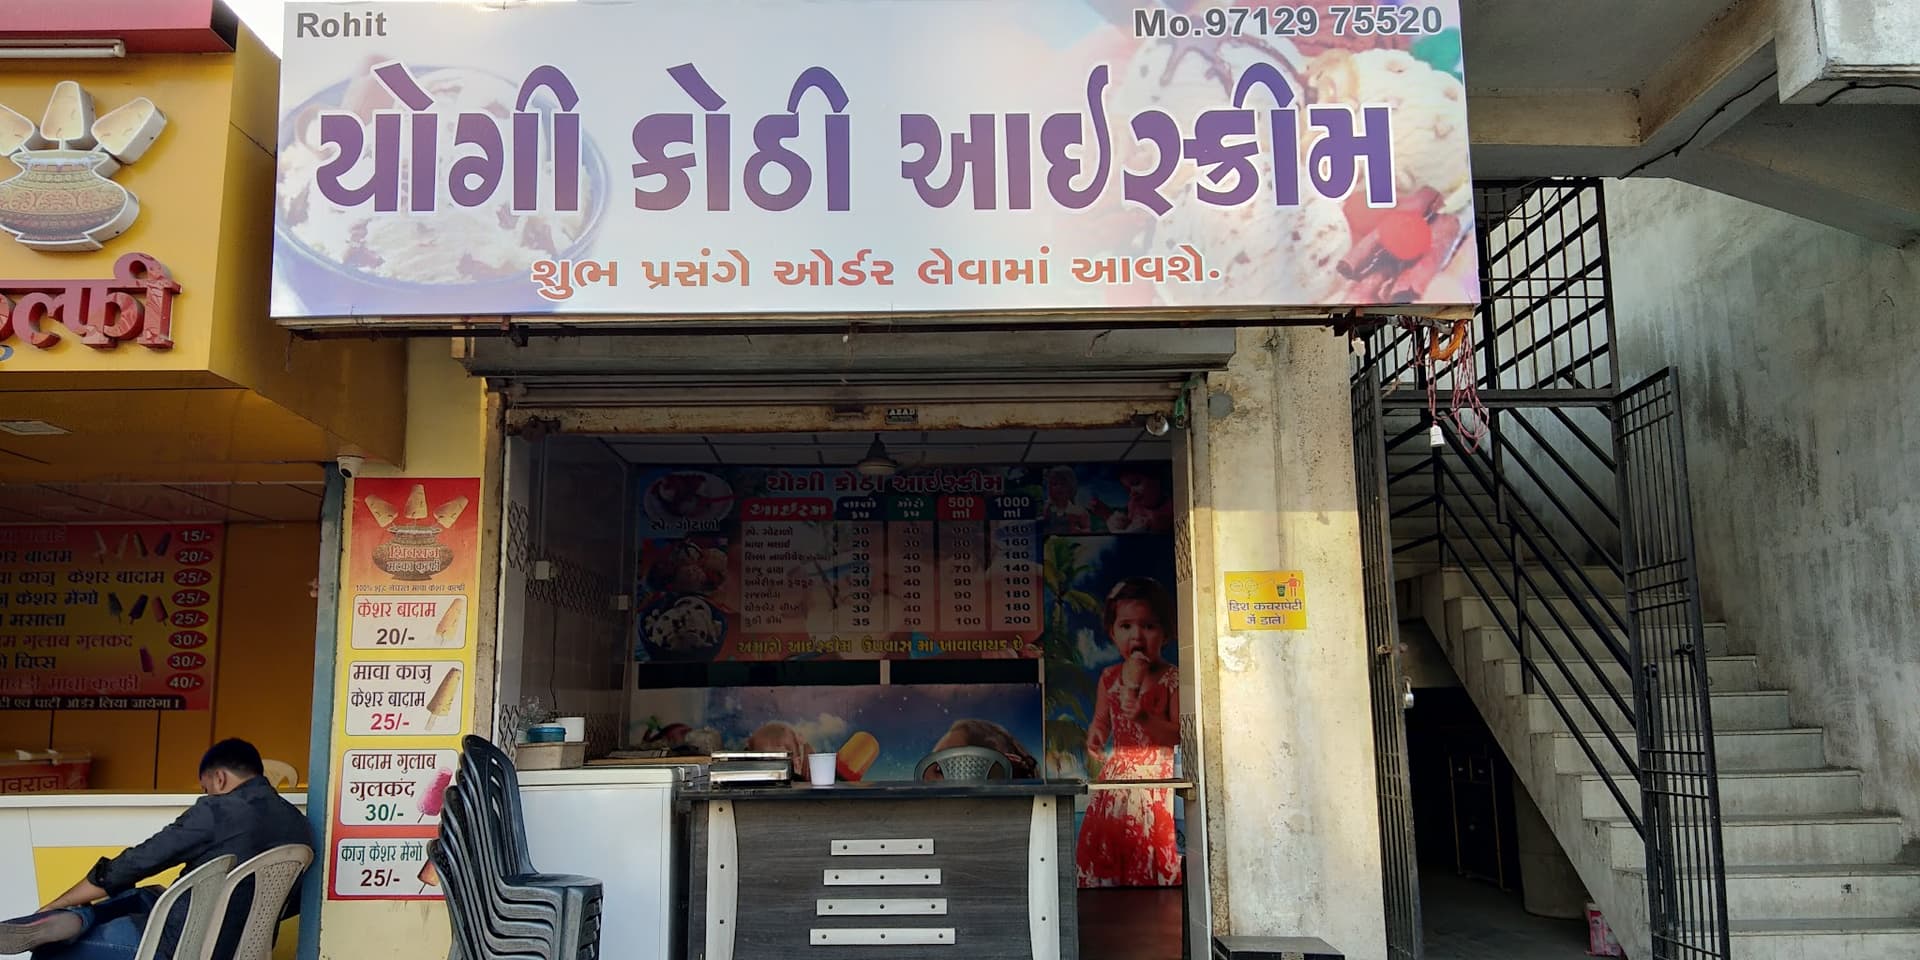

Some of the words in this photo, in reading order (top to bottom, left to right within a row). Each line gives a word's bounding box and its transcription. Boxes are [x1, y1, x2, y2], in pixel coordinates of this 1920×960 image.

[296, 11, 387, 38] Rohit
[1133, 7, 1319, 40] Mo.97129
[1331, 4, 1444, 37] 75520
[315, 61, 581, 213] યોગી
[630, 61, 851, 213] કોઠી
[531, 259, 618, 301] શુભ
[641, 247, 750, 290] પ્રસંગે
[773, 247, 894, 286] ઓર્ડર
[917, 244, 1050, 286] લેવામાં
[0, 252, 183, 352] ल्फी
[766, 471, 825, 492] યોગી
[947, 496, 975, 508] 500
[995, 495, 1030, 508] 1000
[951, 507, 971, 519] ml
[1003, 507, 1021, 519] ml
[181, 530, 211, 541] 15/-
[852, 526, 870, 535] 30
[852, 539, 870, 548] 20
[179, 550, 210, 562] 20/-
[852, 552, 870, 561] 30
[904, 552, 921, 561] 40
[954, 552, 971, 561] 90
[1005, 551, 1031, 560] 180
[67, 569, 111, 585] केशर
[116, 570, 165, 585] बादाम
[177, 572, 209, 584] 25/-
[852, 565, 870, 574] 20
[904, 565, 921, 574] 30
[954, 565, 971, 574] 70
[1005, 564, 1031, 573] 140
[852, 578, 870, 587] 30
[904, 578, 921, 587] 40
[954, 578, 971, 587] 90
[1005, 577, 1031, 586] 180
[16, 590, 57, 606] केशर
[176, 592, 207, 604] 25/-
[852, 591, 870, 600] 30
[904, 591, 921, 600] 40
[954, 591, 971, 600] 90
[1005, 590, 1031, 599] 180
[357, 599, 393, 618] केशर
[396, 601, 438, 618] बादाम
[852, 604, 870, 613] 30
[904, 604, 921, 613] 40
[954, 604, 971, 613] 90
[1005, 603, 1031, 612] 180
[1253, 598, 1303, 611] कचरापेटी
[174, 613, 206, 625] 25/-
[852, 617, 870, 626] 35
[904, 617, 921, 626] 50
[956, 617, 981, 626] 100
[1005, 616, 1031, 625] 200
[173, 634, 205, 646] 30/-
[375, 628, 415, 645] 20/-
[172, 656, 203, 667] 30/-
[168, 676, 201, 688] 40/-
[353, 665, 390, 680] मावा
[396, 665, 433, 684] काजु
[350, 688, 384, 708] केशर
[388, 691, 426, 707] बादाम
[370, 713, 410, 731] 25/-
[351, 753, 392, 770] बादाम
[396, 753, 437, 775] गुलाब
[350, 777, 417, 801] गुलकंद
[364, 803, 404, 821] 30/-
[341, 845, 366, 865] काजु
[369, 841, 397, 862] केशर
[360, 869, 400, 887] 25/-
